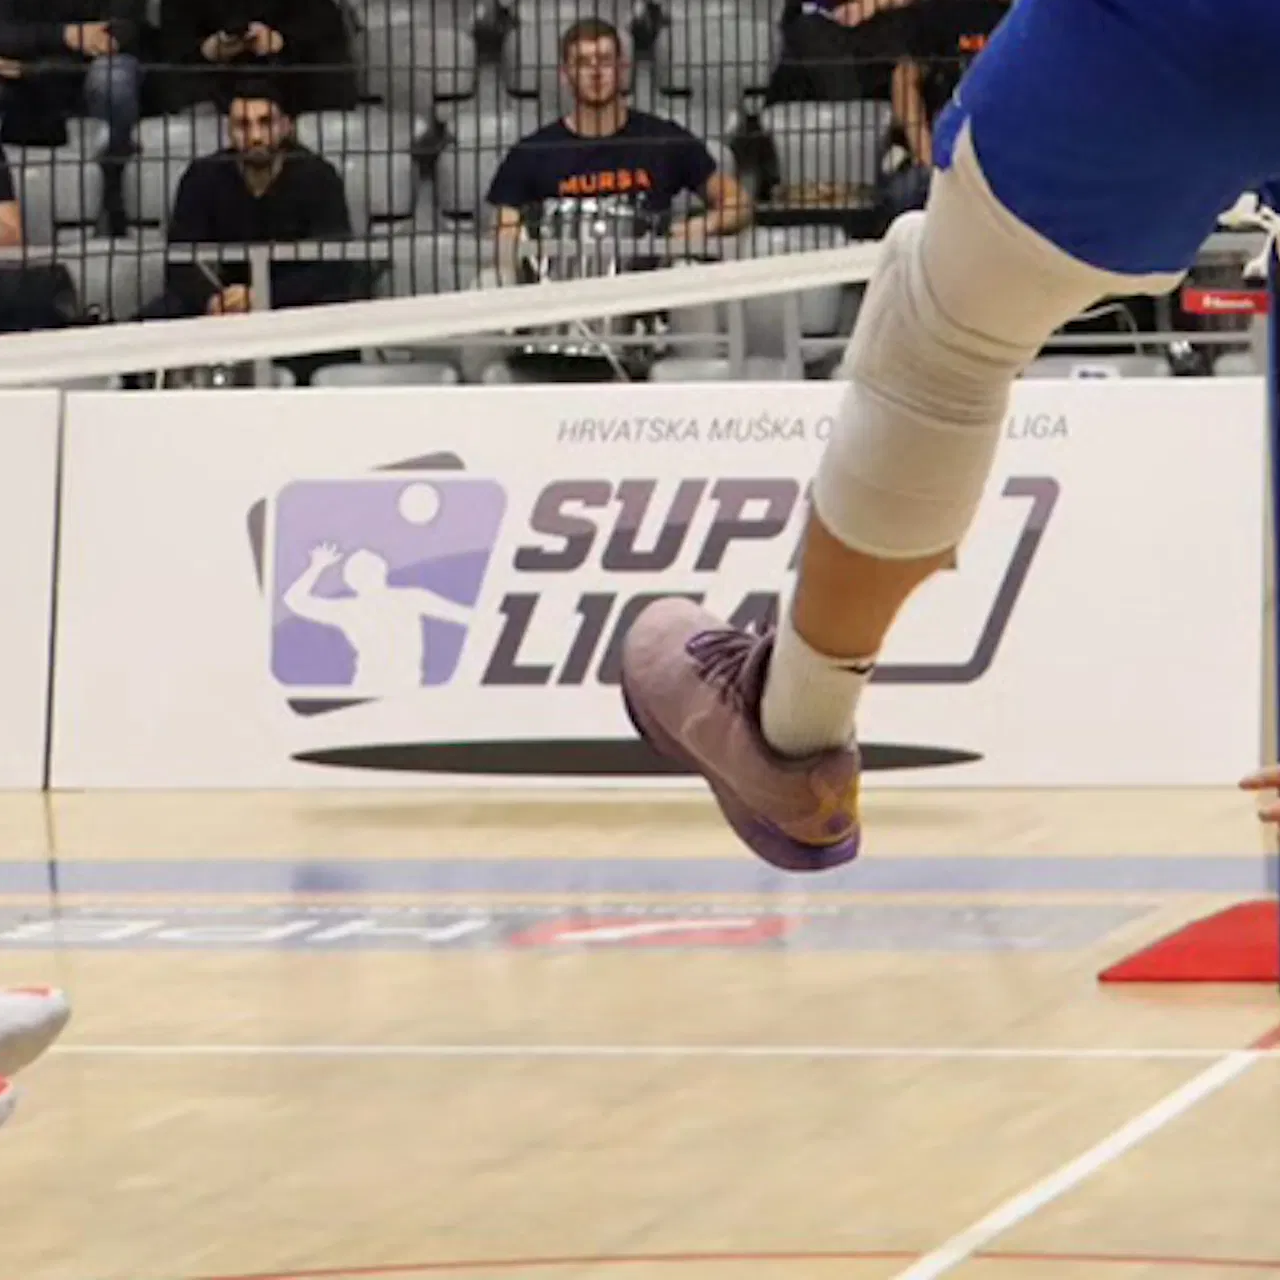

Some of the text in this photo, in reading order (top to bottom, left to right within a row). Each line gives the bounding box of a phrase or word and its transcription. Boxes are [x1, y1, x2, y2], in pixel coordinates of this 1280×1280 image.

[556, 416, 701, 443] HRVATSKA
[708, 410, 807, 443] MUŠKA
[1006, 414, 1070, 440] LIGA
[513, 477, 958, 572] SUP
